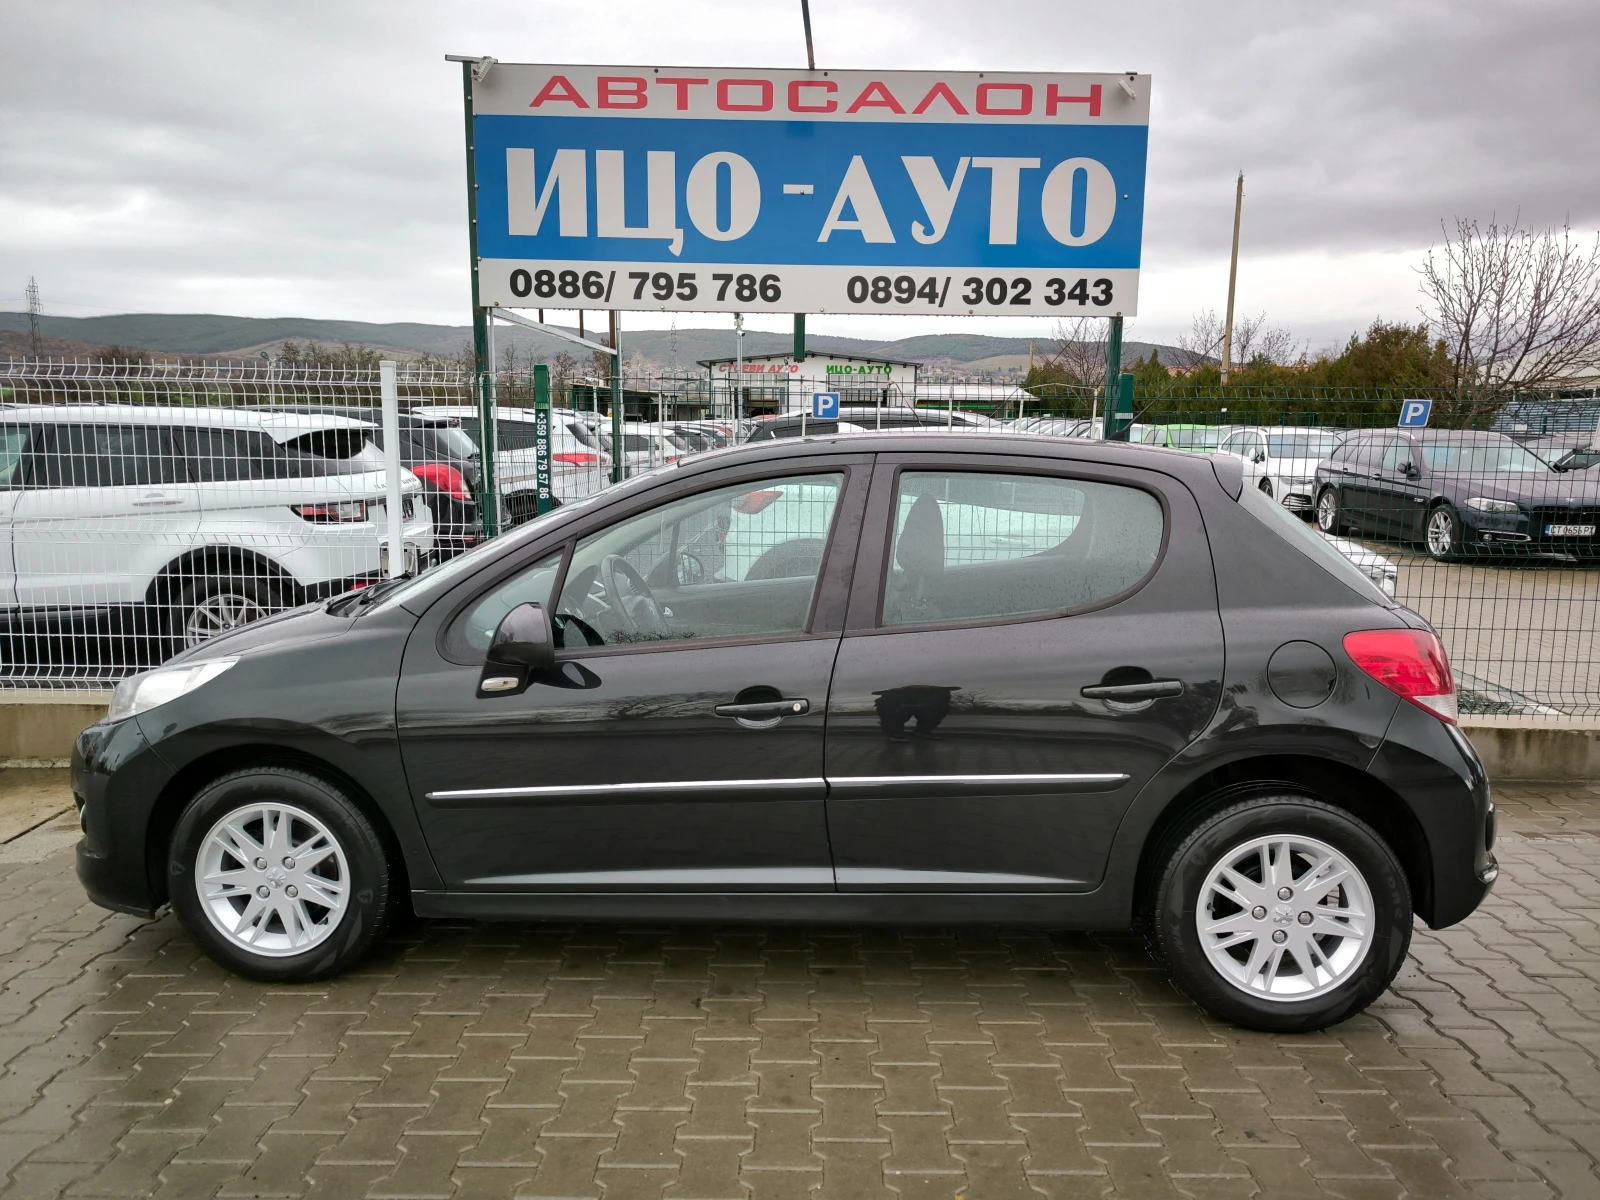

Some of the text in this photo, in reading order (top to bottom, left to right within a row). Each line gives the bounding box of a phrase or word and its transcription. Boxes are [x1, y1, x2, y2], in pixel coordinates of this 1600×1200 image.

[530, 75, 1102, 118] АВТОСАЛОН
[508, 268, 782, 303] 0886/ 795 786
[846, 275, 1114, 308] 0894/ 302 343
[719, 363, 765, 373] СТЕВИ
[818, 396, 834, 416] P
[1405, 403, 1425, 424] P
[537, 412, 549, 499] +359 886 79 57 86
